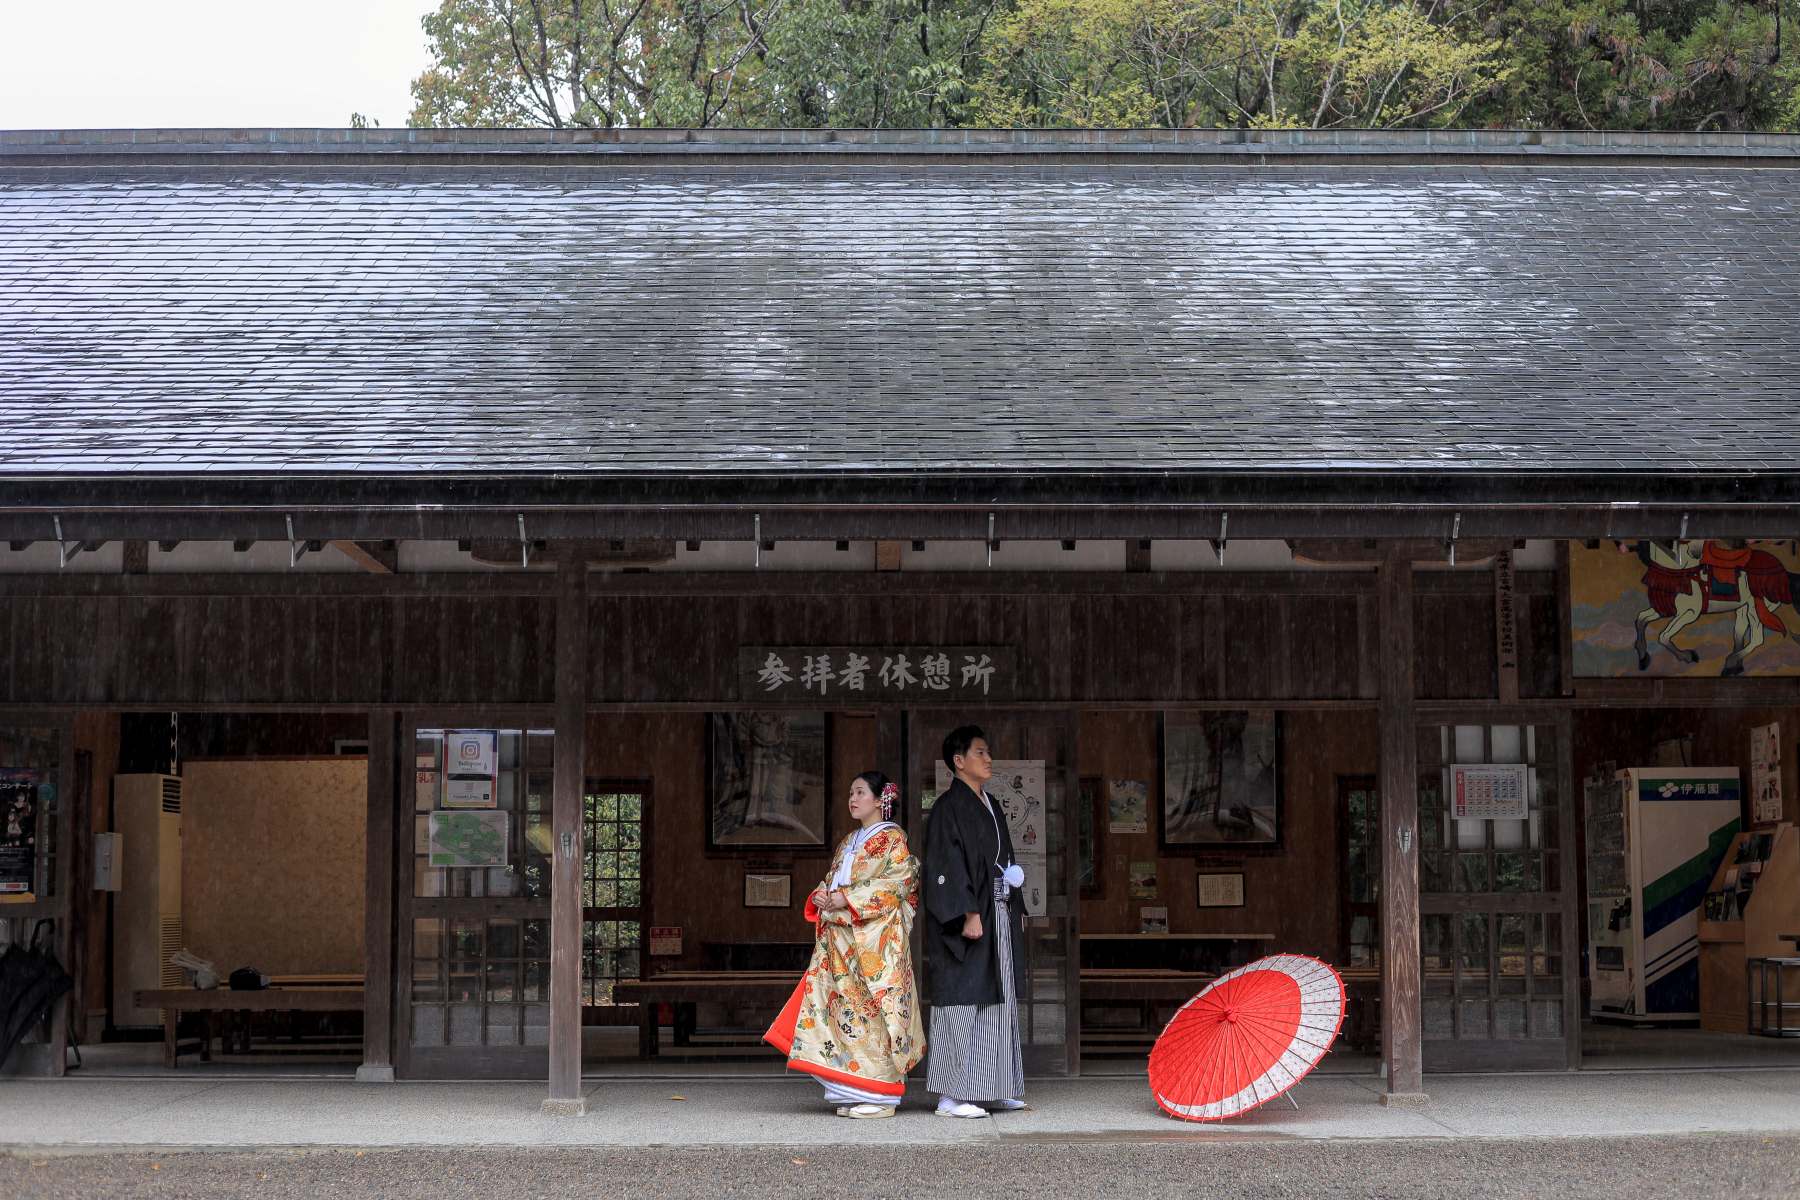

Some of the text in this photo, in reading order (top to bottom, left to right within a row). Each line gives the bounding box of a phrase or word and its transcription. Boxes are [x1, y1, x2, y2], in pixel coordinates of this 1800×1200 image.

[757, 652, 996, 695] 参拝者休憩所
[1680, 783, 1719, 795] 伊藤園
